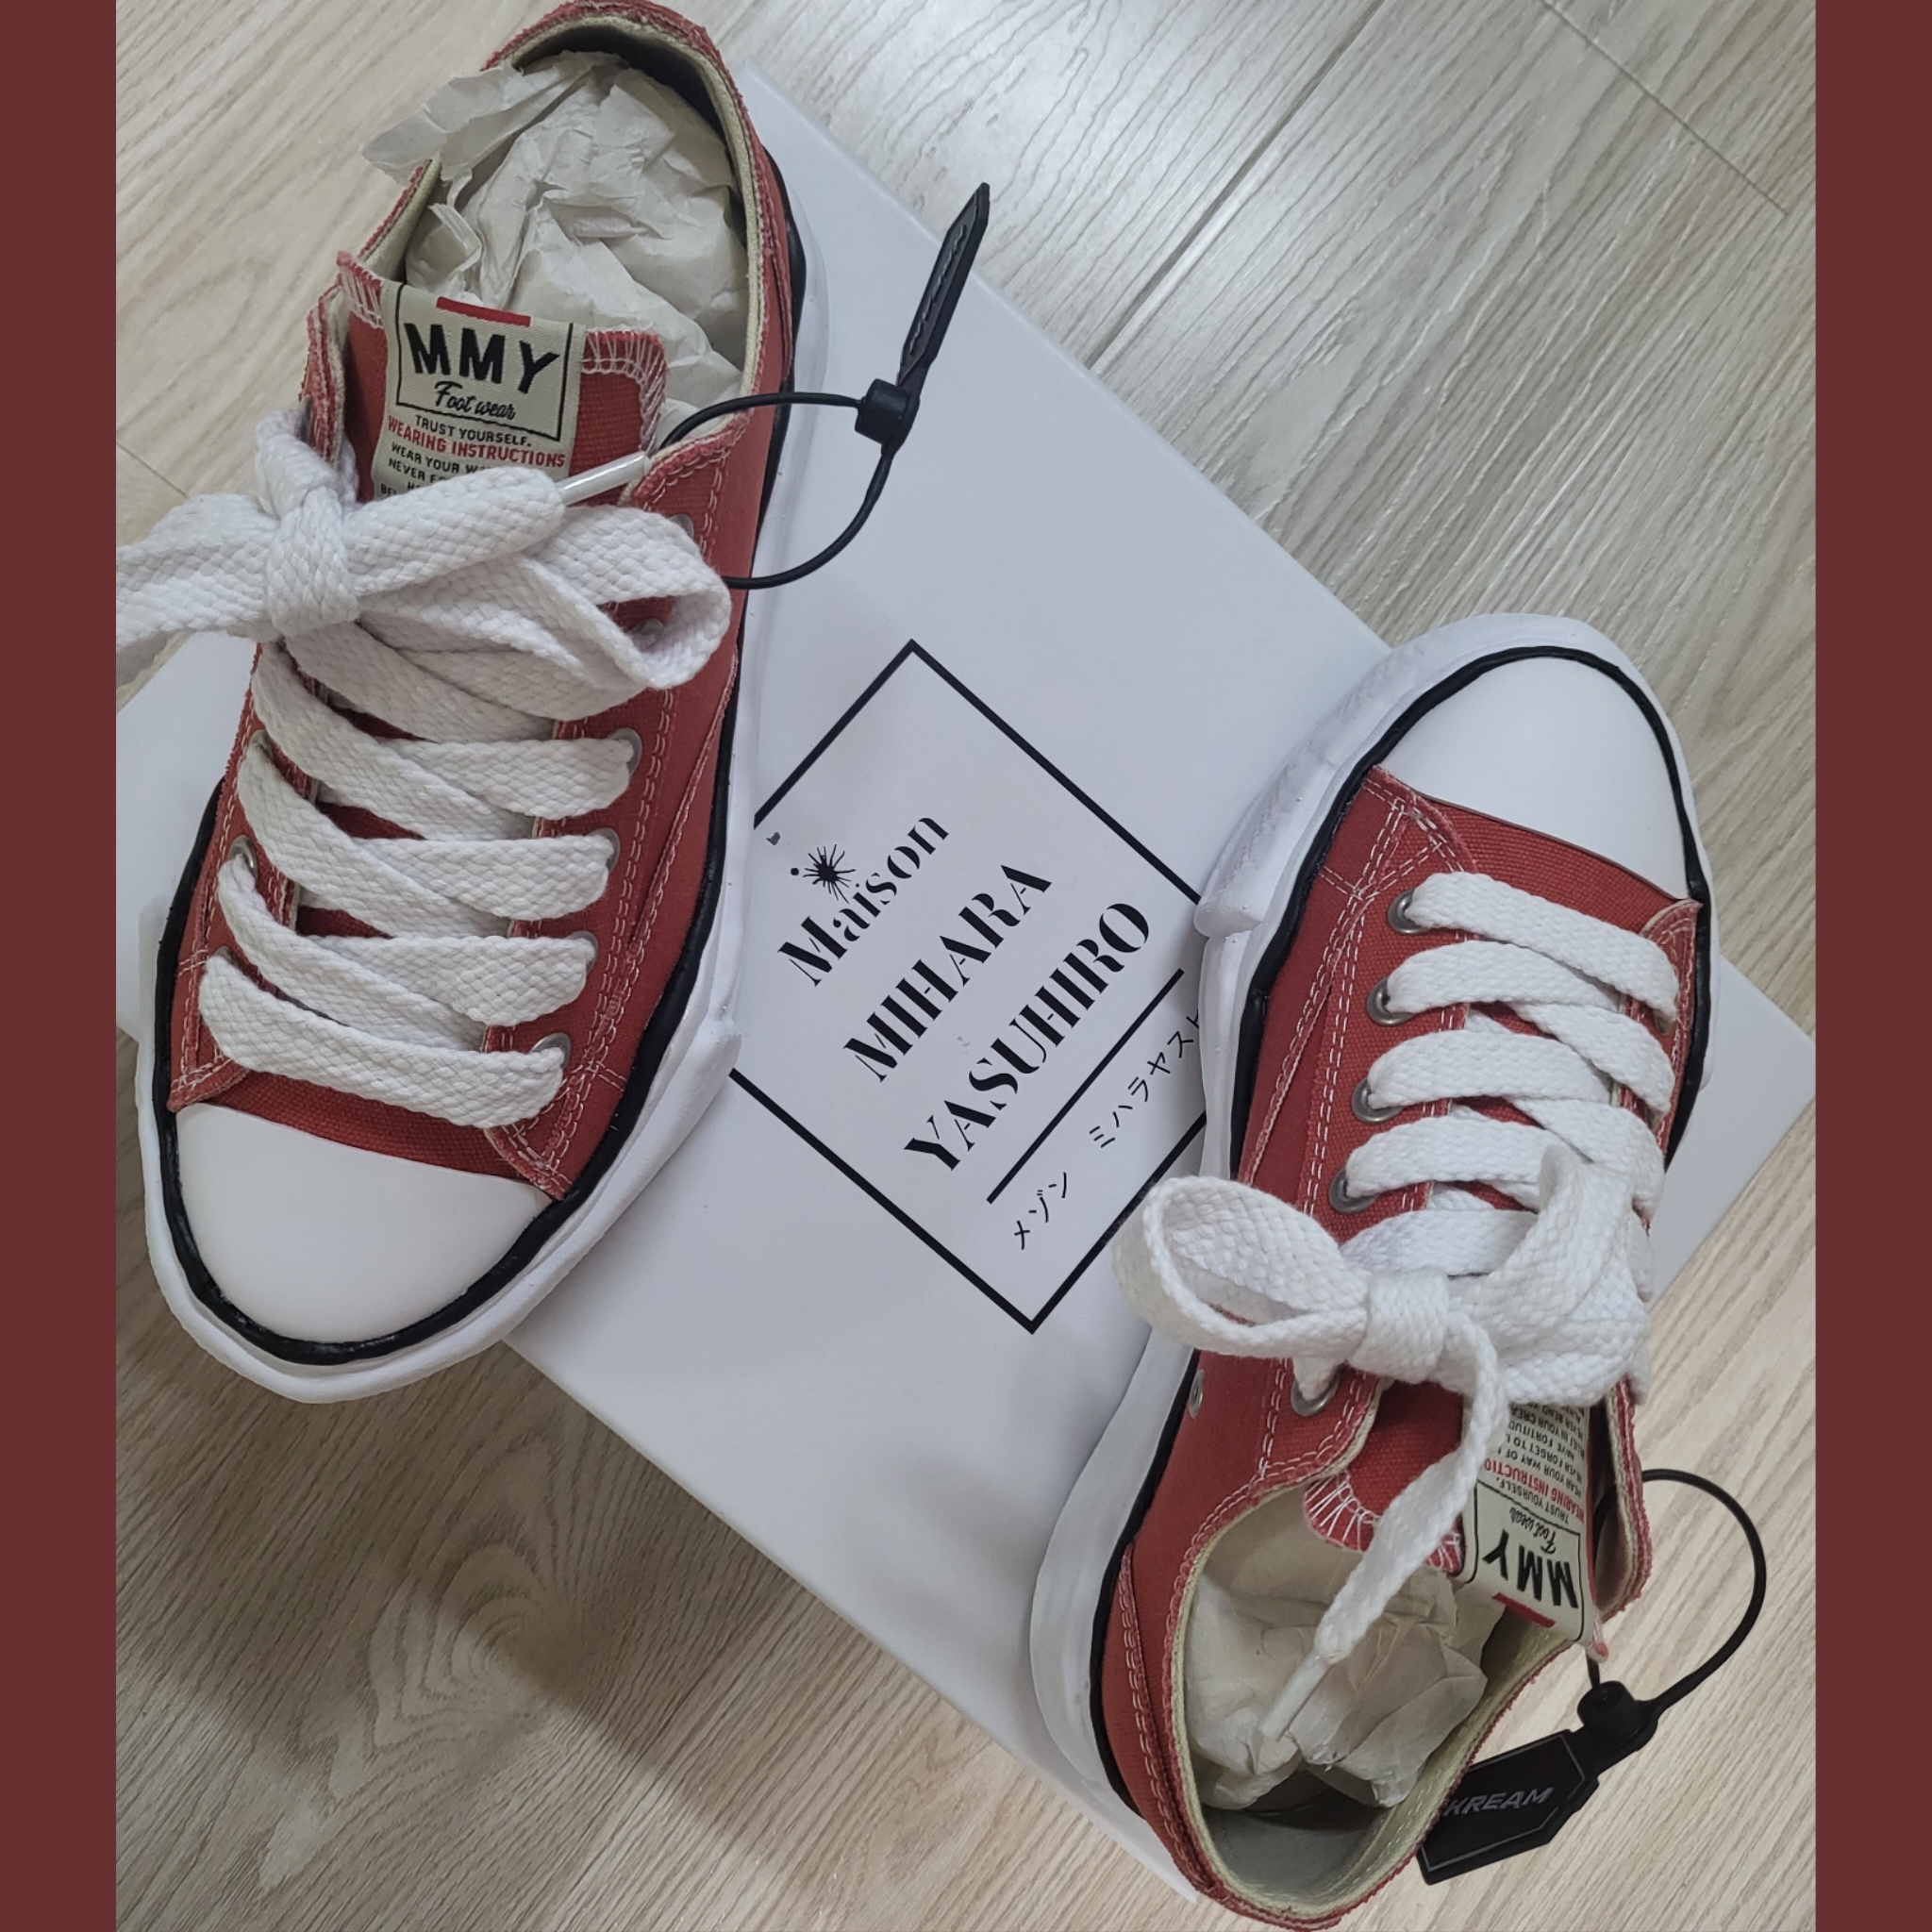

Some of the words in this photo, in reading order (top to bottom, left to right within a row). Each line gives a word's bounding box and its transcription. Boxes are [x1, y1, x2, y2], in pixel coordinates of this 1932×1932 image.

[404, 323, 560, 394] MMY
[435, 381, 476, 411] Foot
[475, 400, 516, 421] wear
[387, 415, 446, 453] WEARING
[451, 441, 566, 468] INSTRUCTIONS
[416, 414, 456, 437] TRUST
[458, 427, 532, 447] YOURSELF.
[389, 458, 425, 480] NEVER
[391, 441, 422, 464] WEAR
[425, 457, 459, 473] YOUR
[777, 817, 949, 987] Maison
[843, 865, 1052, 1082] MIHARA
[904, 903, 1149, 1171] YASUHIRO
[1014, 1172, 1067, 1250] メゾン
[1508, 1421, 1552, 1447] FORTITUD
[1514, 1437, 1526, 1450] TO
[1507, 1449, 1518, 1460] OF
[1521, 1455, 1541, 1471] WAY
[1529, 1443, 1562, 1468] FORGET
[1483, 1458, 1549, 1496] INSTRUCTIO
[1544, 1465, 1564, 1484] YOUR
[1545, 1502, 1569, 1524] TRUST
[1551, 1488, 1584, 1524] WEARING
[1482, 1528, 1578, 1609] MMY
[1442, 1788, 1554, 1817] KREAM
